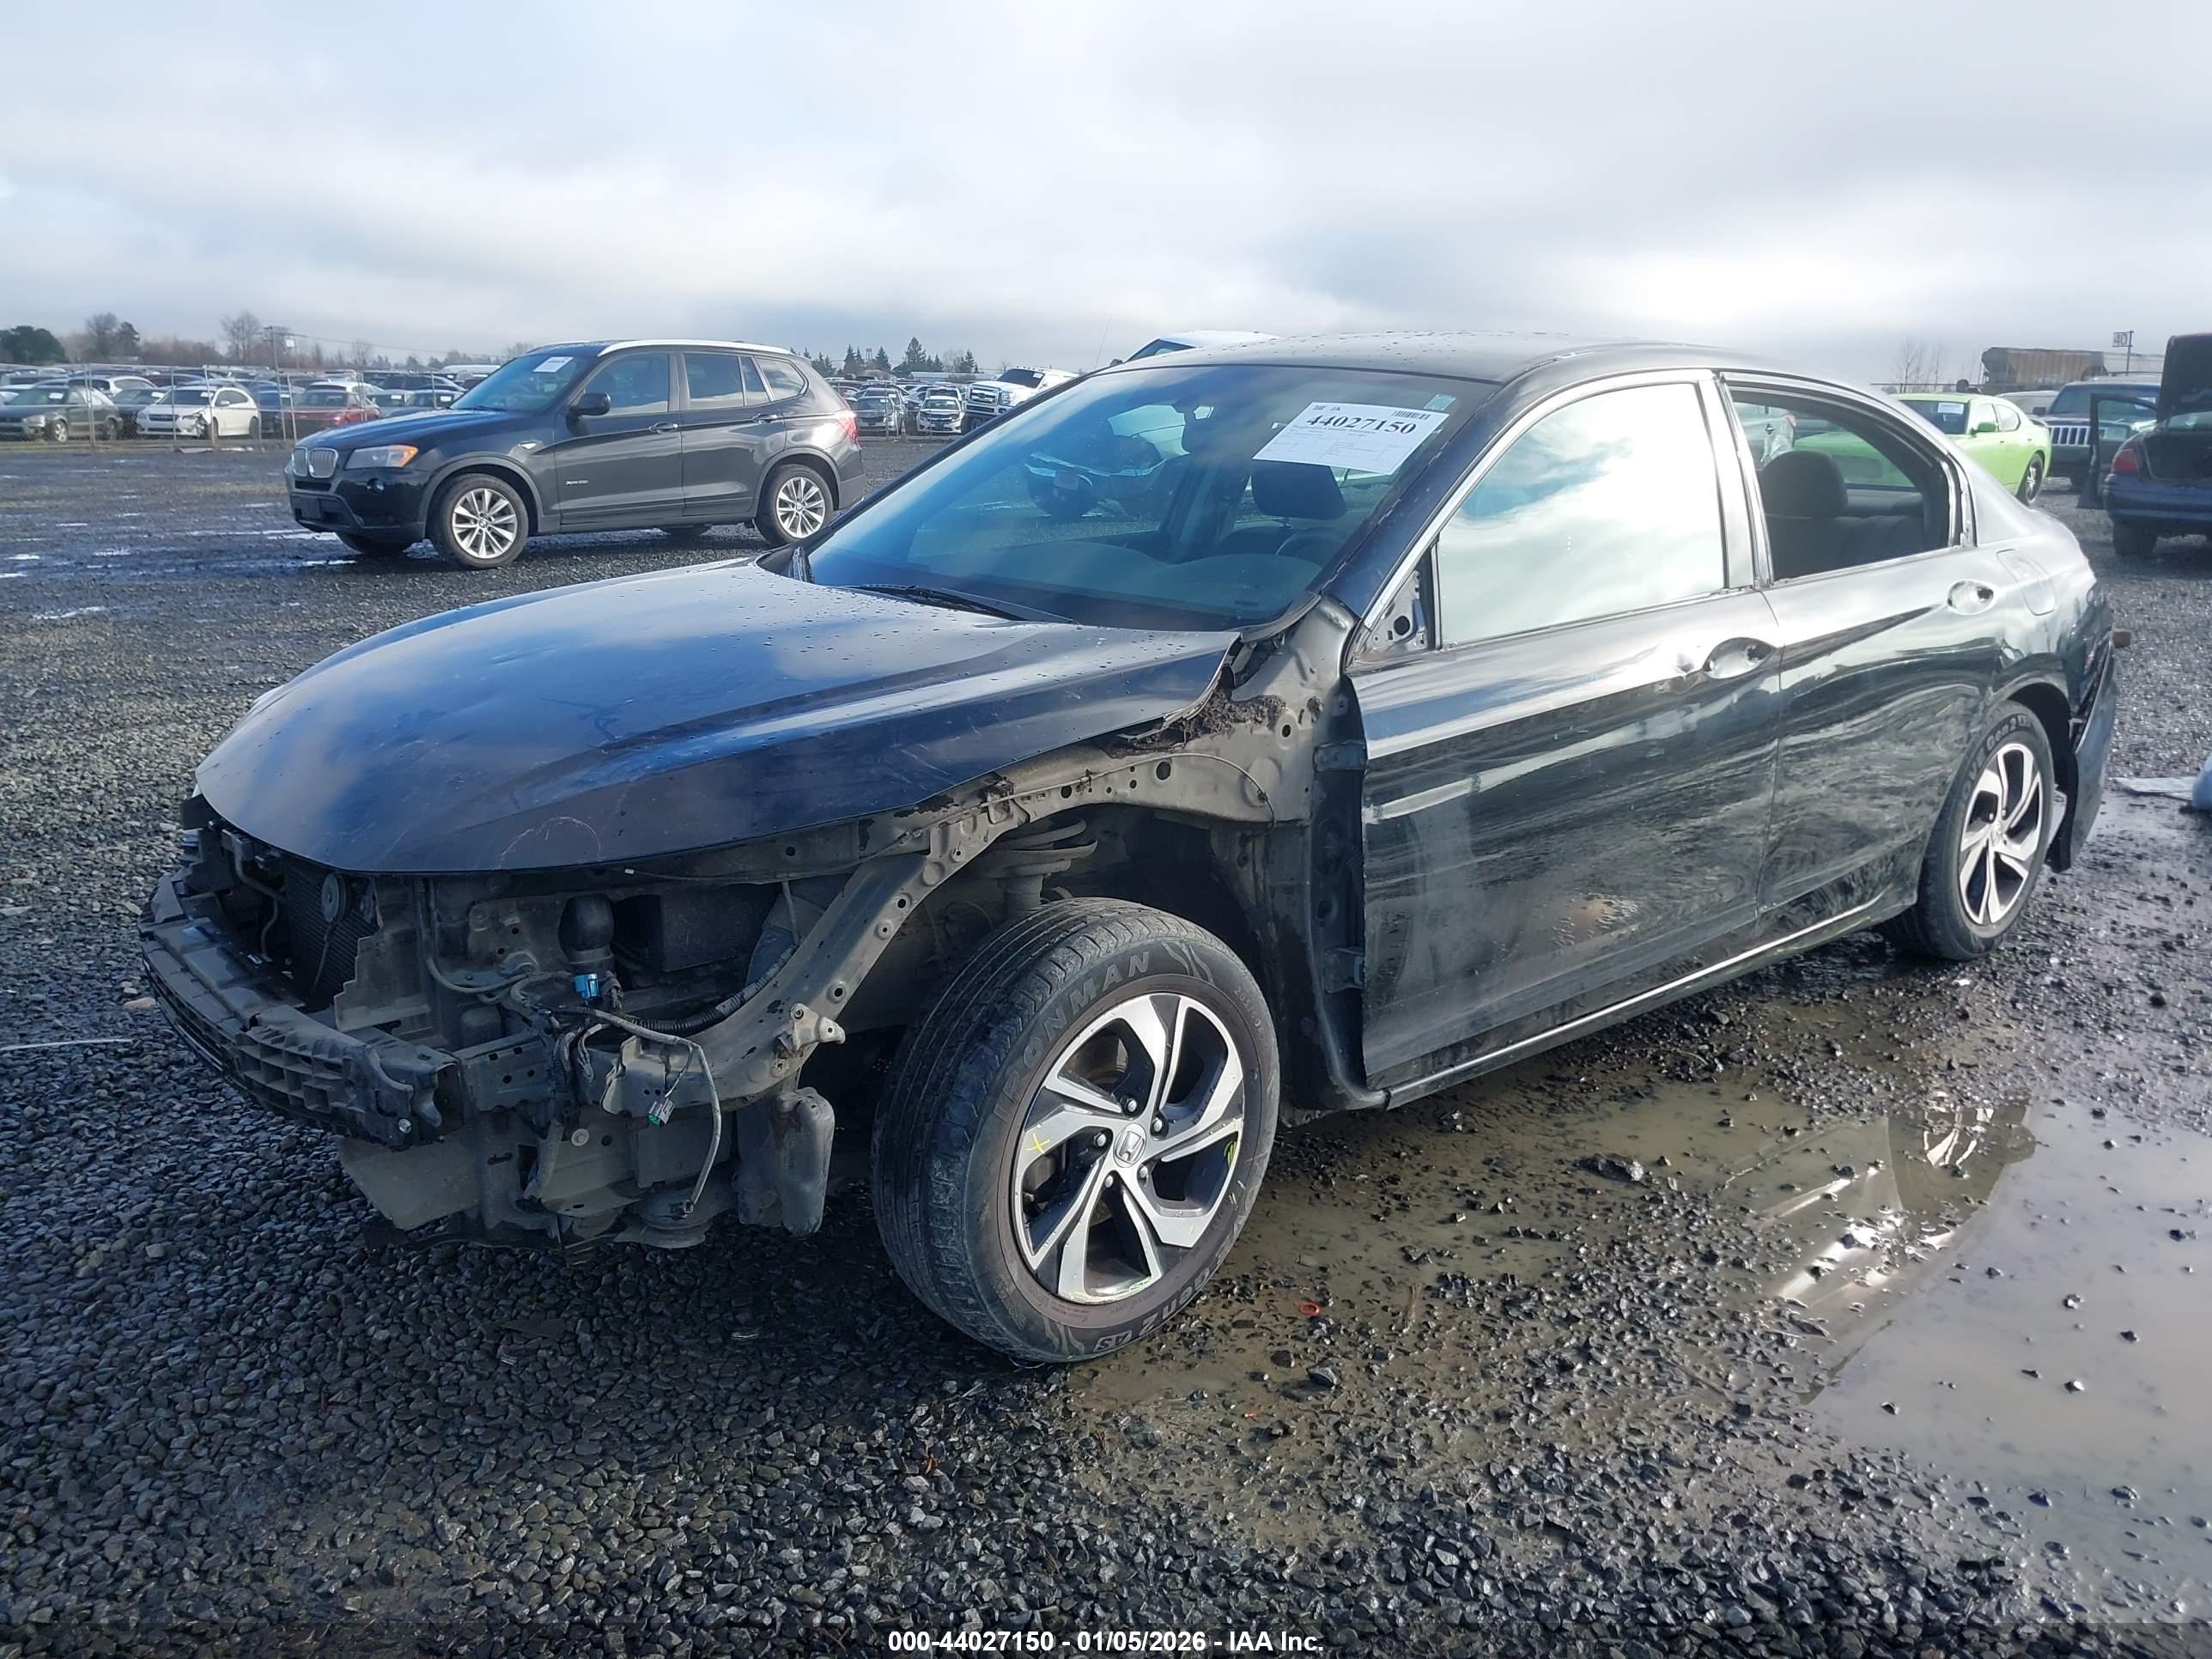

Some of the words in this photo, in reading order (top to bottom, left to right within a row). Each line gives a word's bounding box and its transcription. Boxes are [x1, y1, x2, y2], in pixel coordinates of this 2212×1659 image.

[1306, 415, 1417, 434] 44027150
[994, 951, 1150, 1123] IRONMAN
[1094, 1330, 1132, 1353] AS
